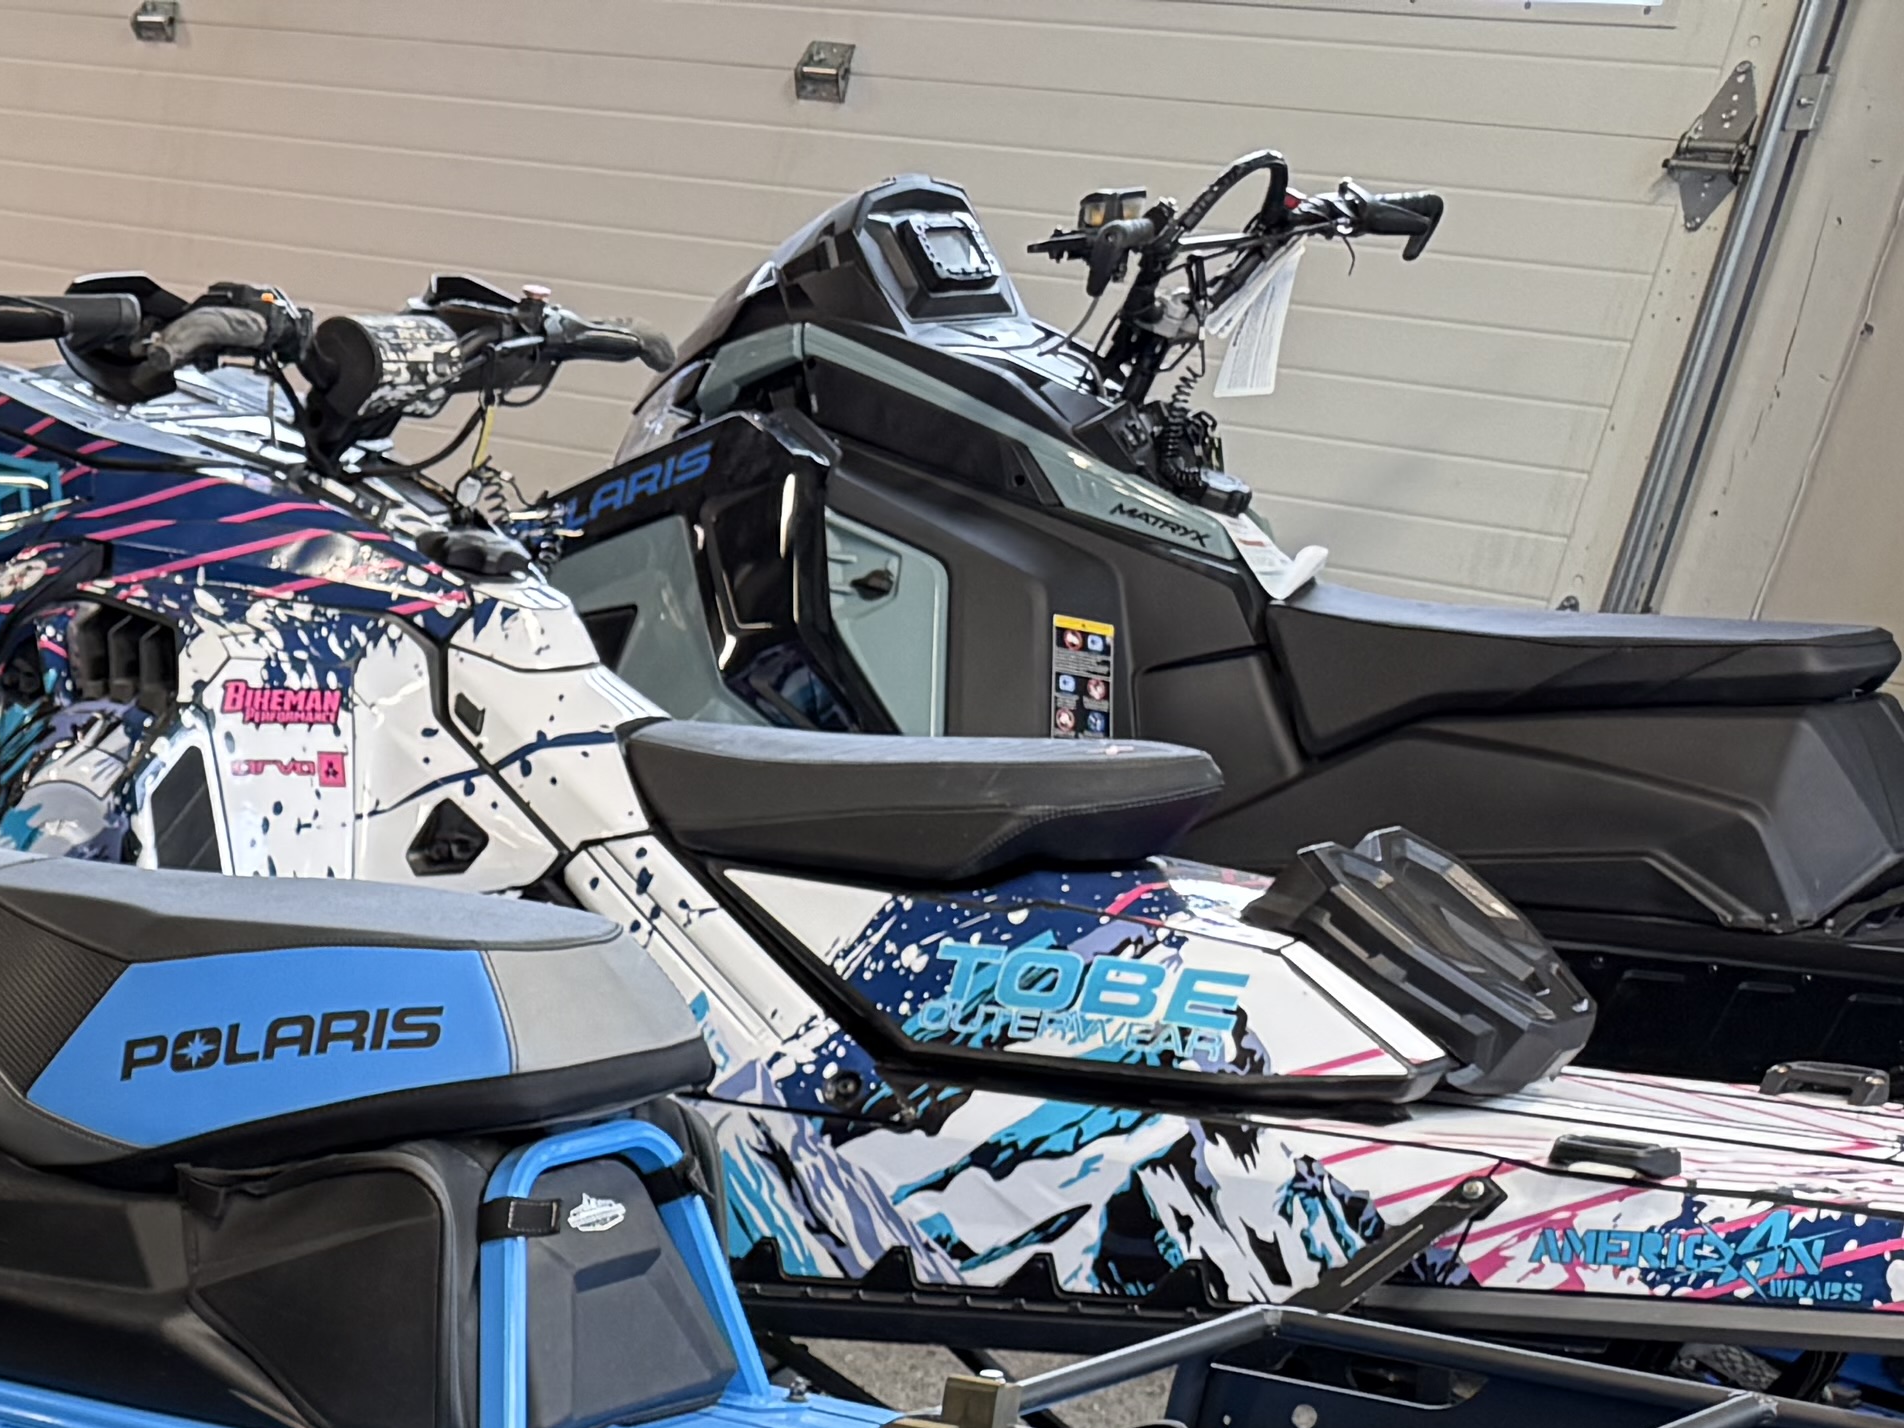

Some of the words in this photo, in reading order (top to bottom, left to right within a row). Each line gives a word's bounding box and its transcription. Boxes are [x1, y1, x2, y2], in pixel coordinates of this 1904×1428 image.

[537, 441, 714, 535] LARIS
[1109, 502, 1210, 548] MATRYX
[243, 707, 338, 724] PERFORMANCE
[937, 941, 1250, 1031] TOBE
[120, 1006, 444, 1081] POLARIS
[918, 1000, 1224, 1062] OUTERWEAR
[1769, 1278, 1864, 1302] WRAPS
